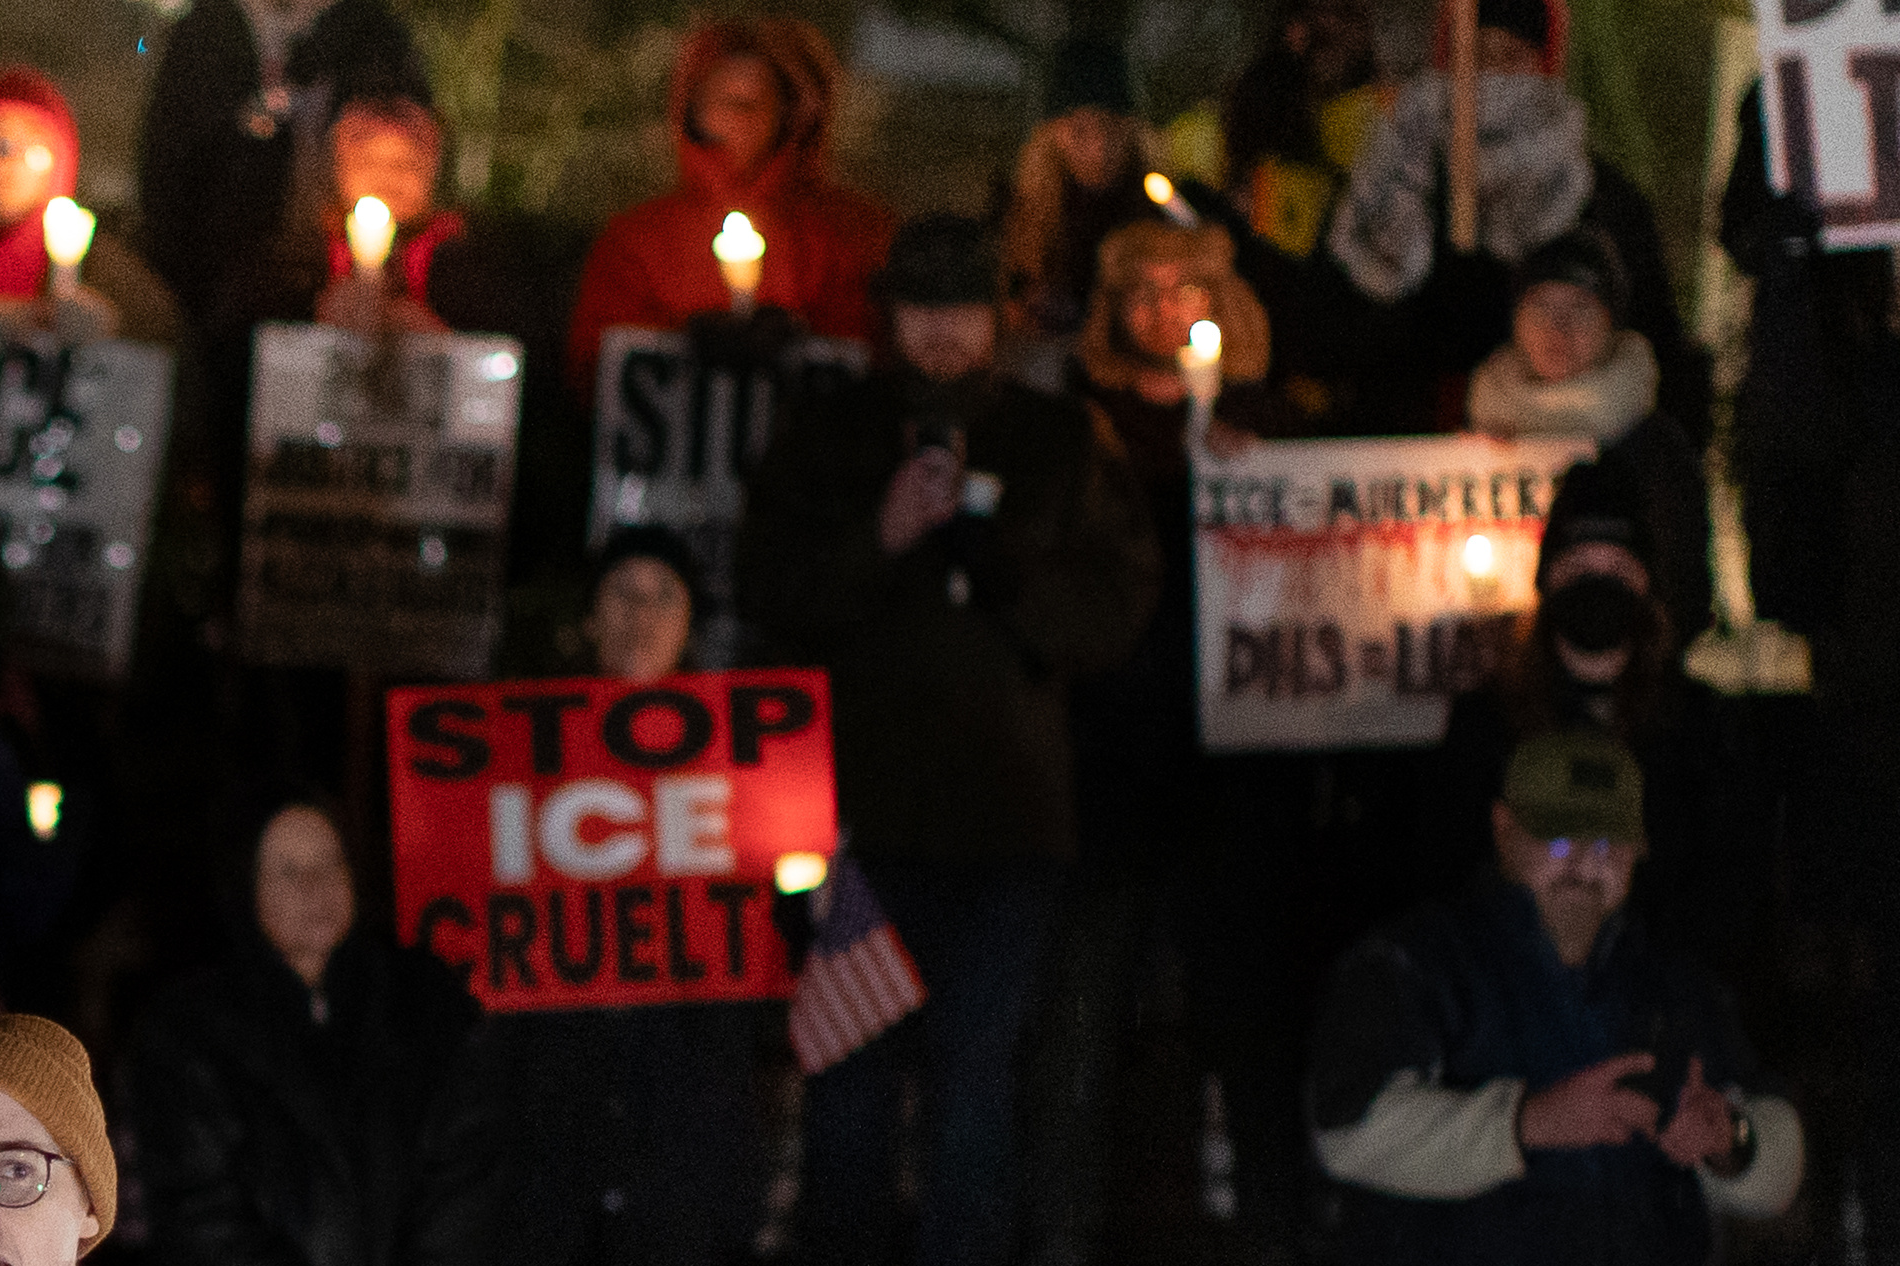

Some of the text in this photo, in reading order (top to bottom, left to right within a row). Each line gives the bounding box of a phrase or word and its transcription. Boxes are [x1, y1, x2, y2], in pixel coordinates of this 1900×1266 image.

[407, 686, 814, 781] STOP
[490, 775, 736, 885] ICE
[418, 884, 760, 989] CRUELT
